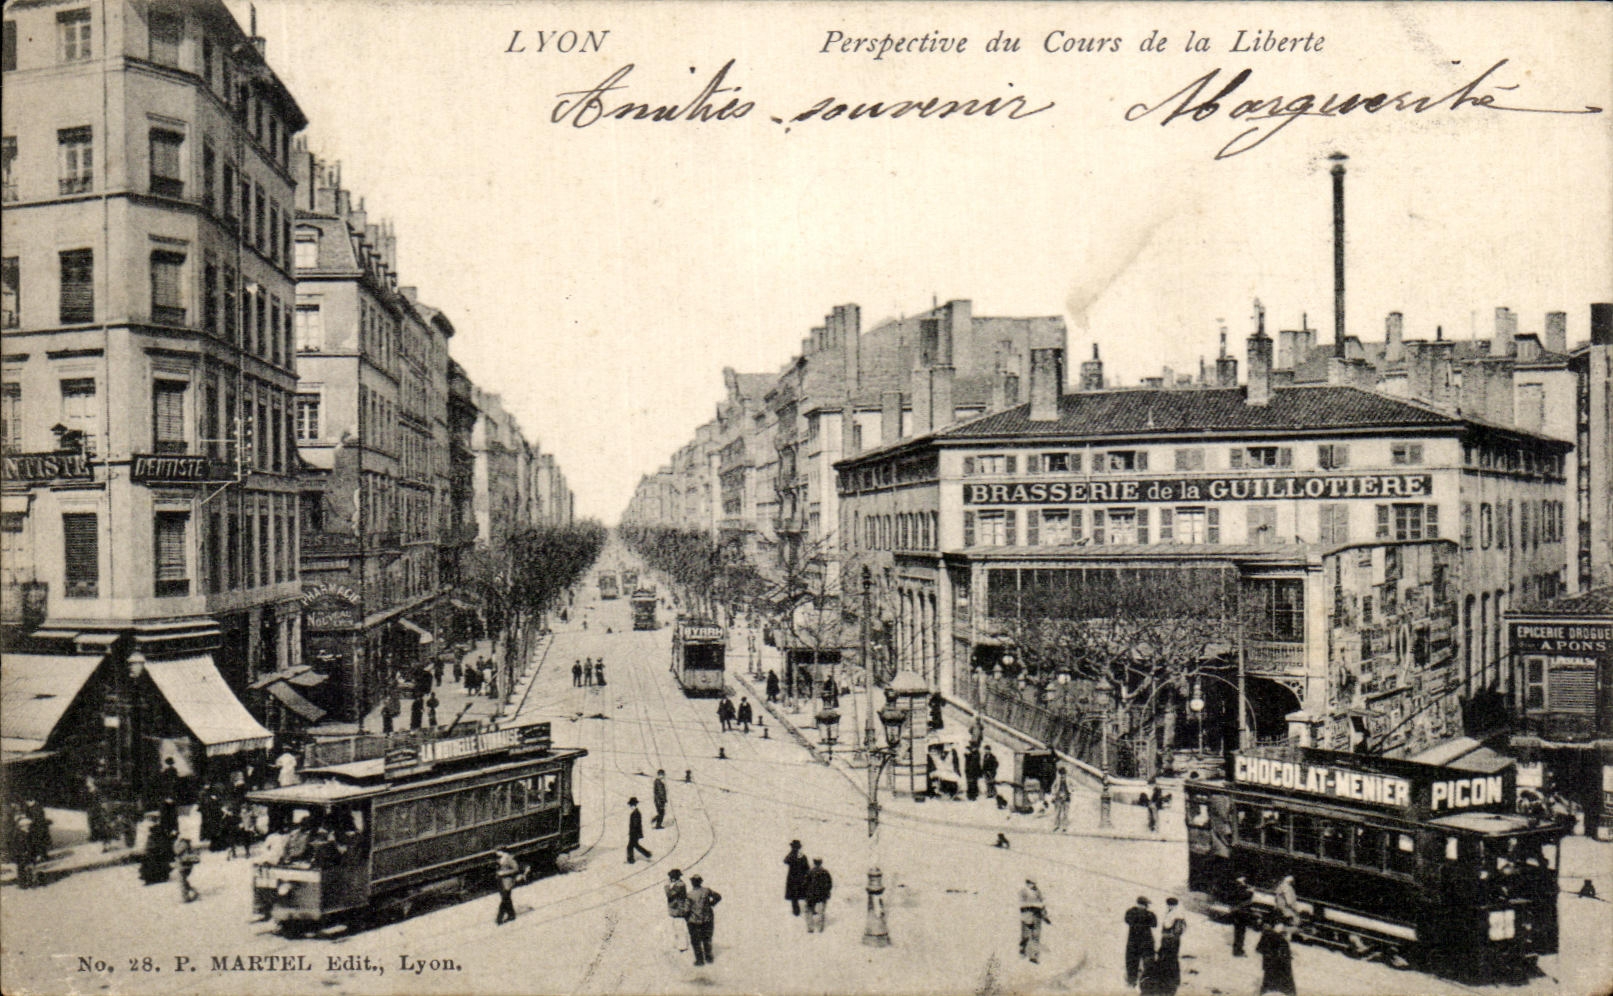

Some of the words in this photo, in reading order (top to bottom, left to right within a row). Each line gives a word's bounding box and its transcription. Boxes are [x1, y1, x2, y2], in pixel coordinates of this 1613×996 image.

[135, 457, 204, 476] DENTISTE
[970, 482, 1140, 503] BRASSERIE
[1147, 482, 1174, 500] de
[1180, 480, 1201, 499] la
[1517, 626, 1566, 639] EPICERIE
[1568, 627, 1613, 640] DROGUE
[1540, 641, 1553, 650] A
[1556, 641, 1607, 652] PONS
[1234, 755, 1411, 806] CHOCOLAT-MENIER
[1430, 776, 1503, 811] PICON
